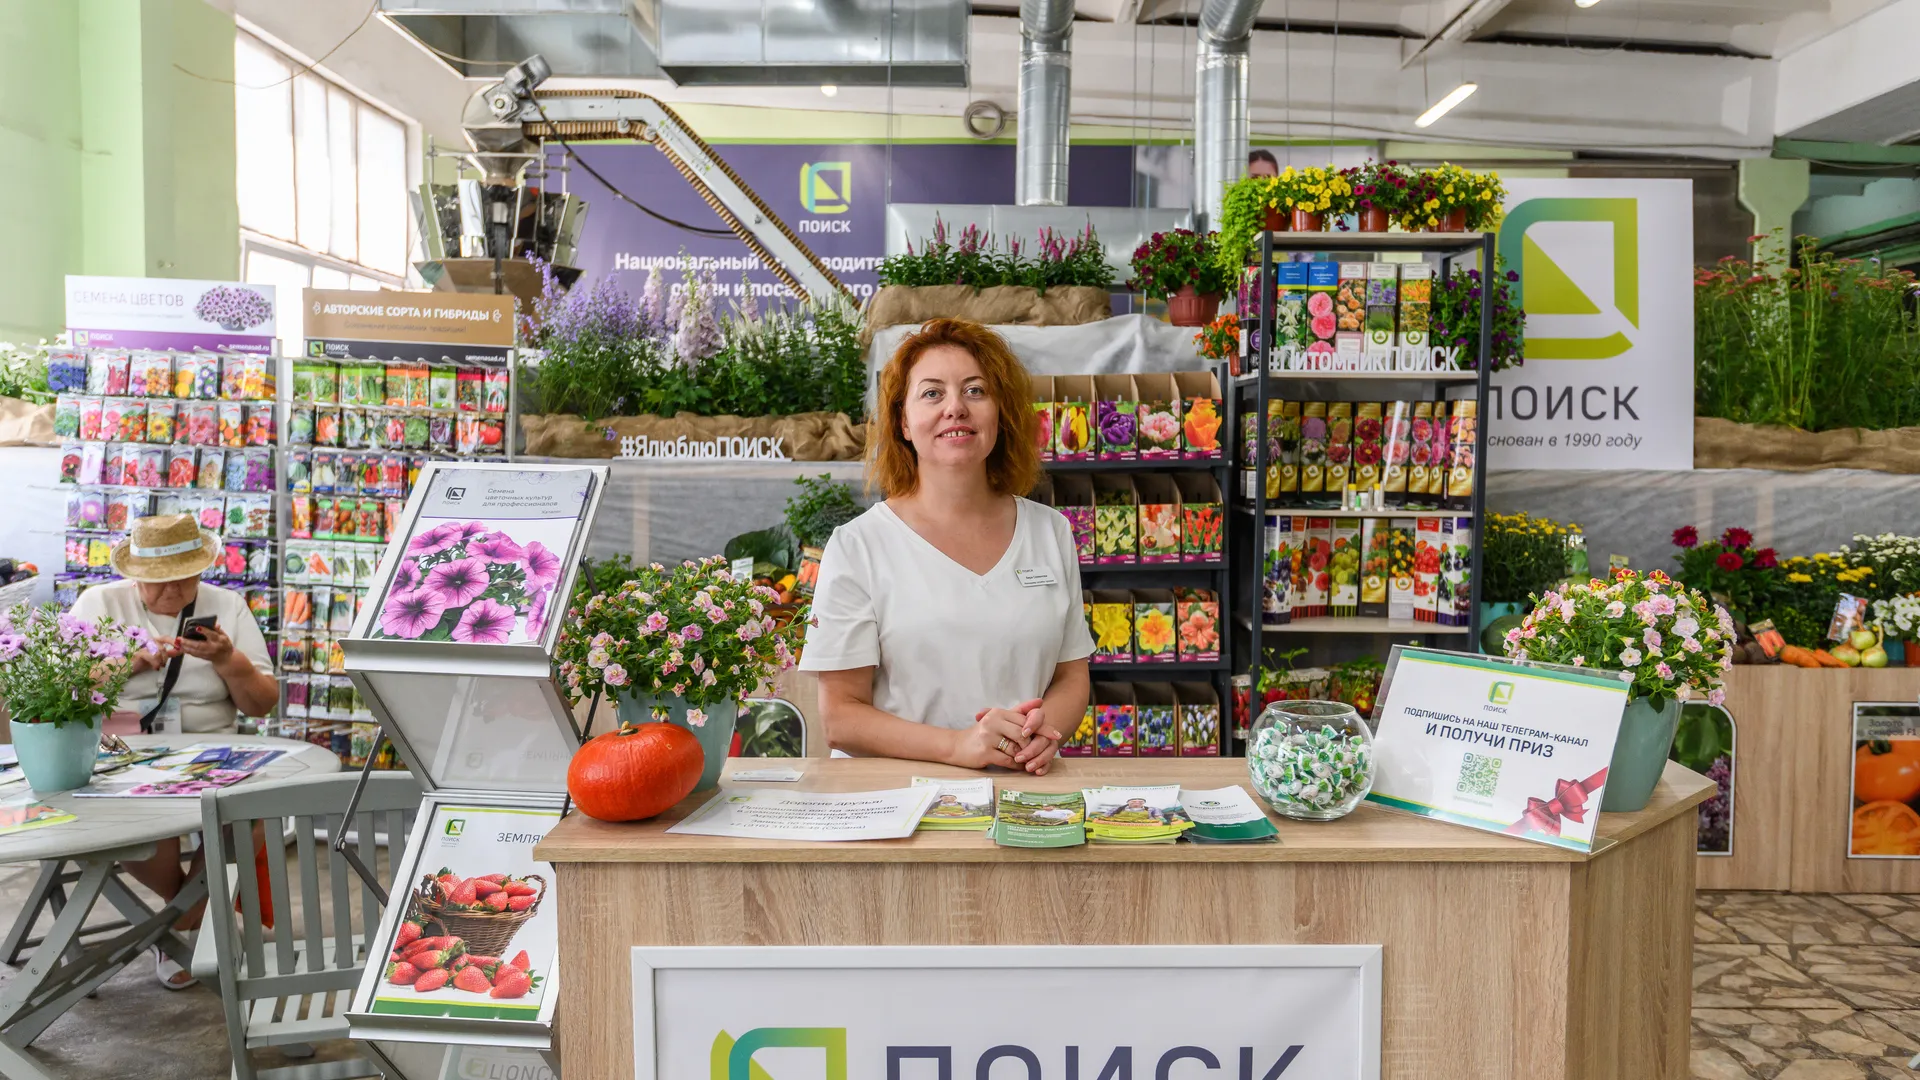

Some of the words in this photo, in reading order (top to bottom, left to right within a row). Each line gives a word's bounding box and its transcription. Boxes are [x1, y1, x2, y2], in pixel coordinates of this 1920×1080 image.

[799, 219, 851, 233] ПОИСК
[73, 290, 127, 304] СЕМЕНА
[130, 293, 184, 307] ЦВЕТОВ
[323, 303, 384, 317] АВТОРСКИЕ
[386, 306, 421, 318] СОРТА
[423, 307, 431, 318] И
[434, 308, 489, 321] ГИБРИДЫ
[325, 343, 349, 351] ПОИСК
[465, 354, 506, 362] semenasad.ru
[620, 435, 785, 459] #ЯлюблюПОИСК
[1488, 435, 1543, 447] снован
[1548, 435, 1557, 447] в
[1564, 433, 1602, 447] 1990
[1606, 433, 1643, 450] году
[1483, 704, 1507, 714] ПОИСК
[1404, 706, 1461, 724] ПОДПИШИСЬ
[1462, 717, 1476, 727] НА
[1477, 719, 1499, 731] НАШ
[1426, 722, 1438, 736] И
[1440, 725, 1505, 748] ПОЛУЧИ
[1508, 738, 1554, 758] ПРИЗ
